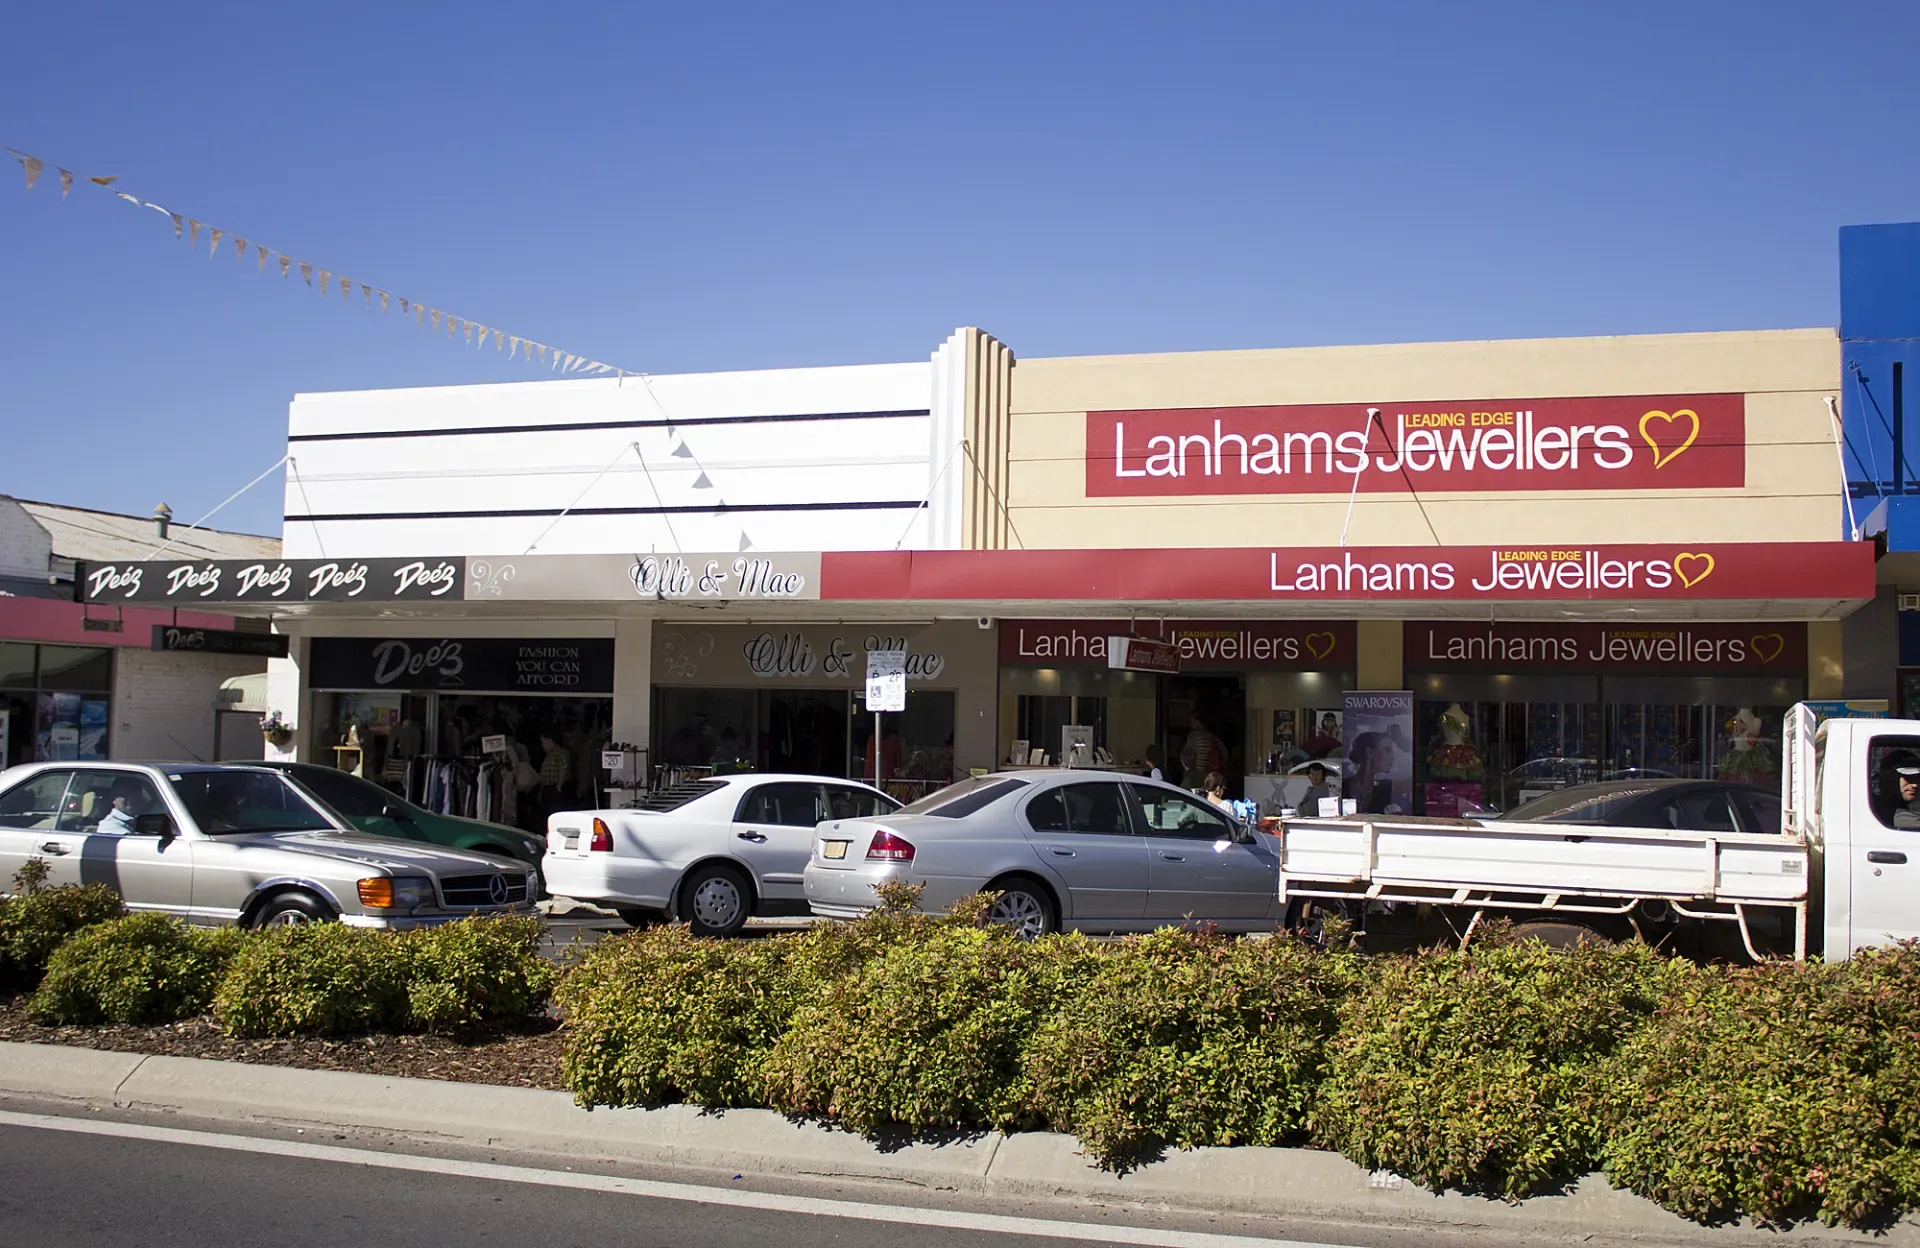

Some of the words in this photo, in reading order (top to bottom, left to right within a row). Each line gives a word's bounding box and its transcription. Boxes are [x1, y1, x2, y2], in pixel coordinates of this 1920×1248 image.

[1405, 413, 1465, 428] LEADING
[1471, 411, 1514, 426] EDGE
[1115, 419, 1369, 478] Lanhams
[1376, 410, 1634, 474] Jewellers
[1498, 550, 1547, 562] LEADING
[1551, 550, 1582, 562] EDGE
[628, 556, 694, 596] Olli
[699, 559, 728, 596] &
[732, 556, 805, 597] Mac
[1270, 551, 1455, 593] Lanhams
[1472, 549, 1672, 592] Jewellers
[1178, 630, 1214, 639] LEADING
[1215, 630, 1239, 639] EDGE
[1609, 631, 1648, 640] LEADING
[1651, 631, 1677, 640] EDGE
[1018, 629, 1107, 658] Lanha
[1428, 630, 1578, 661] Lanhams
[1589, 631, 1746, 663] Jewellers
[519, 647, 579, 658] FASHION
[743, 631, 816, 678] Olli
[823, 637, 858, 678] &
[516, 660, 546, 672] YOU
[550, 661, 580, 672] CAN
[516, 674, 580, 685] AFFORD
[1345, 697, 1411, 709] SWAROVSKI
